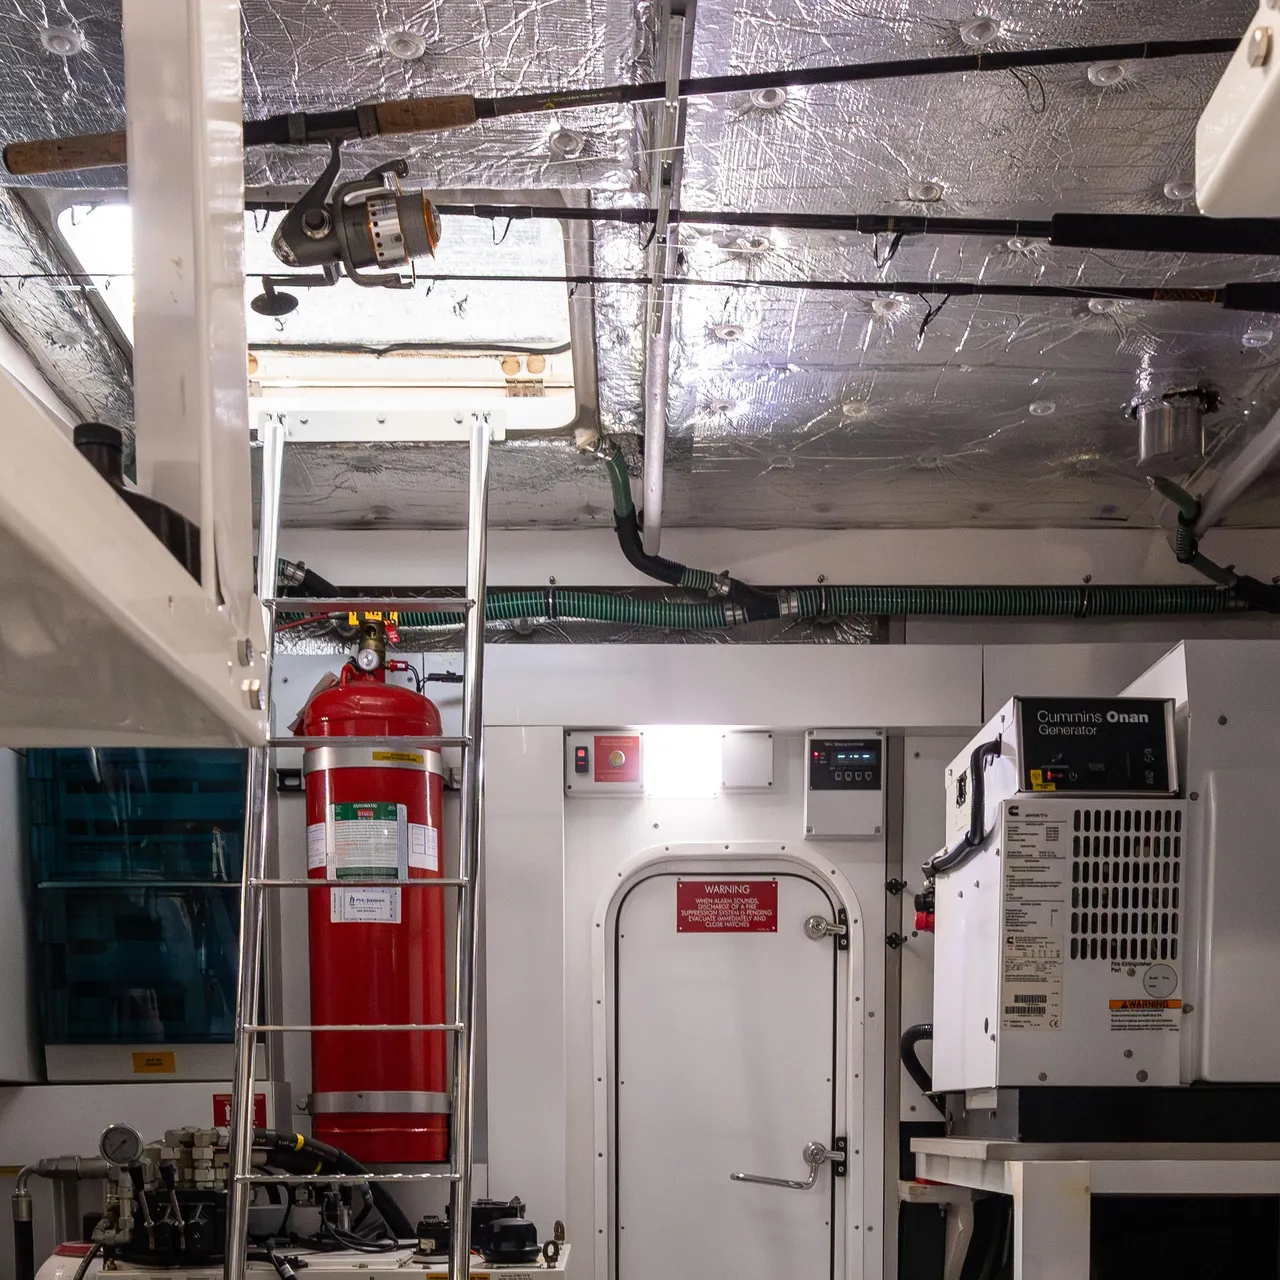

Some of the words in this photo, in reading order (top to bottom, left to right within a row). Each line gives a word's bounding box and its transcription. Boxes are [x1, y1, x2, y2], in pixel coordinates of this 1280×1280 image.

[1037, 710, 1103, 723] Cummins
[1106, 710, 1149, 723] Onan
[1038, 724, 1097, 735] Generator
[705, 885, 750, 894] WARNING
